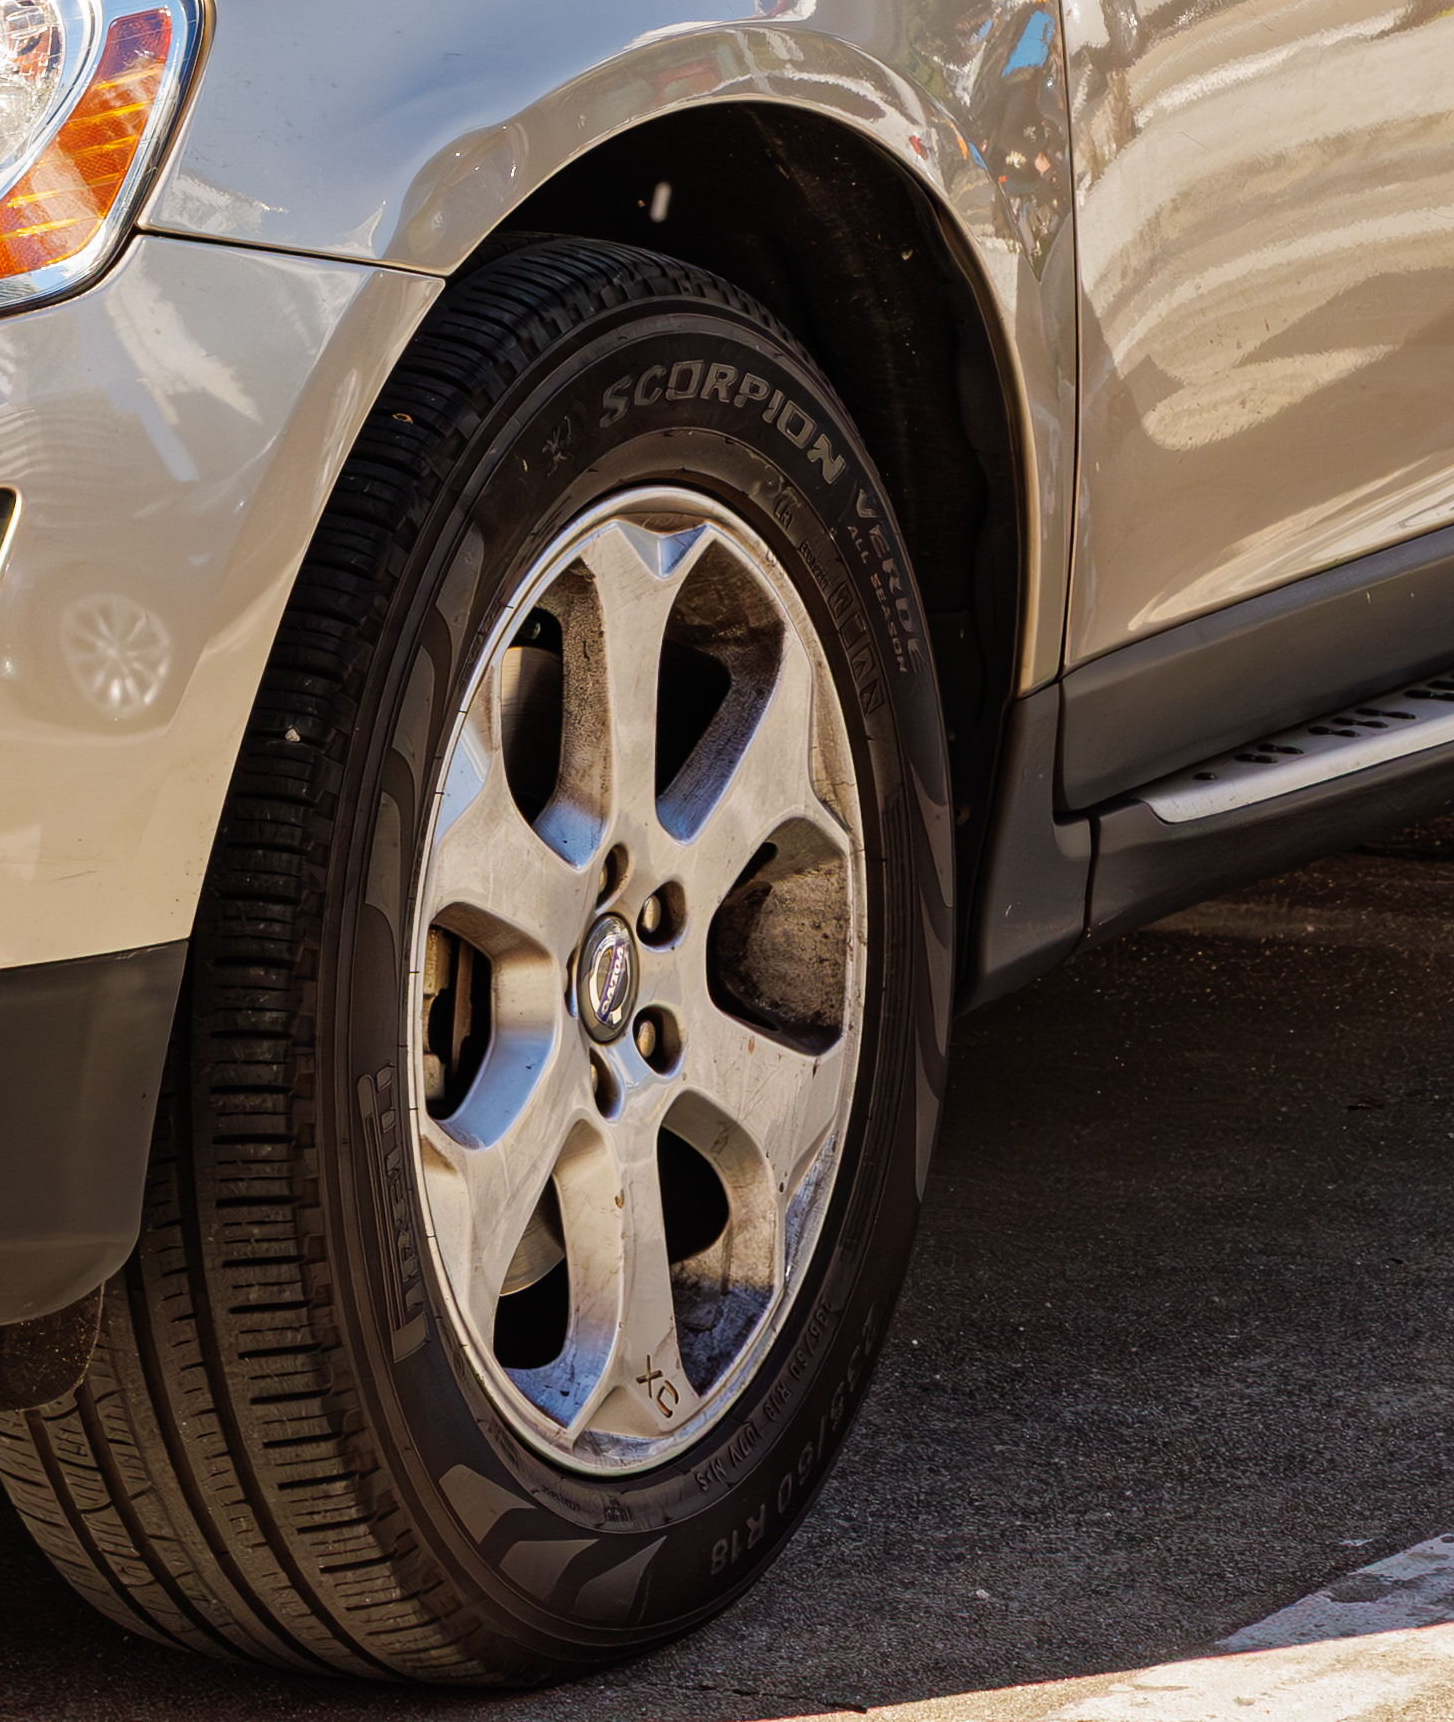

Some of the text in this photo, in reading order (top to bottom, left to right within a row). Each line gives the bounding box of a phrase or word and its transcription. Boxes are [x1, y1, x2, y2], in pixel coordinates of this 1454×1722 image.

[599, 359, 922, 674] SCORPION VERDE
[847, 525, 908, 673] ALL SEASON
[710, 1503, 766, 1575] R18
